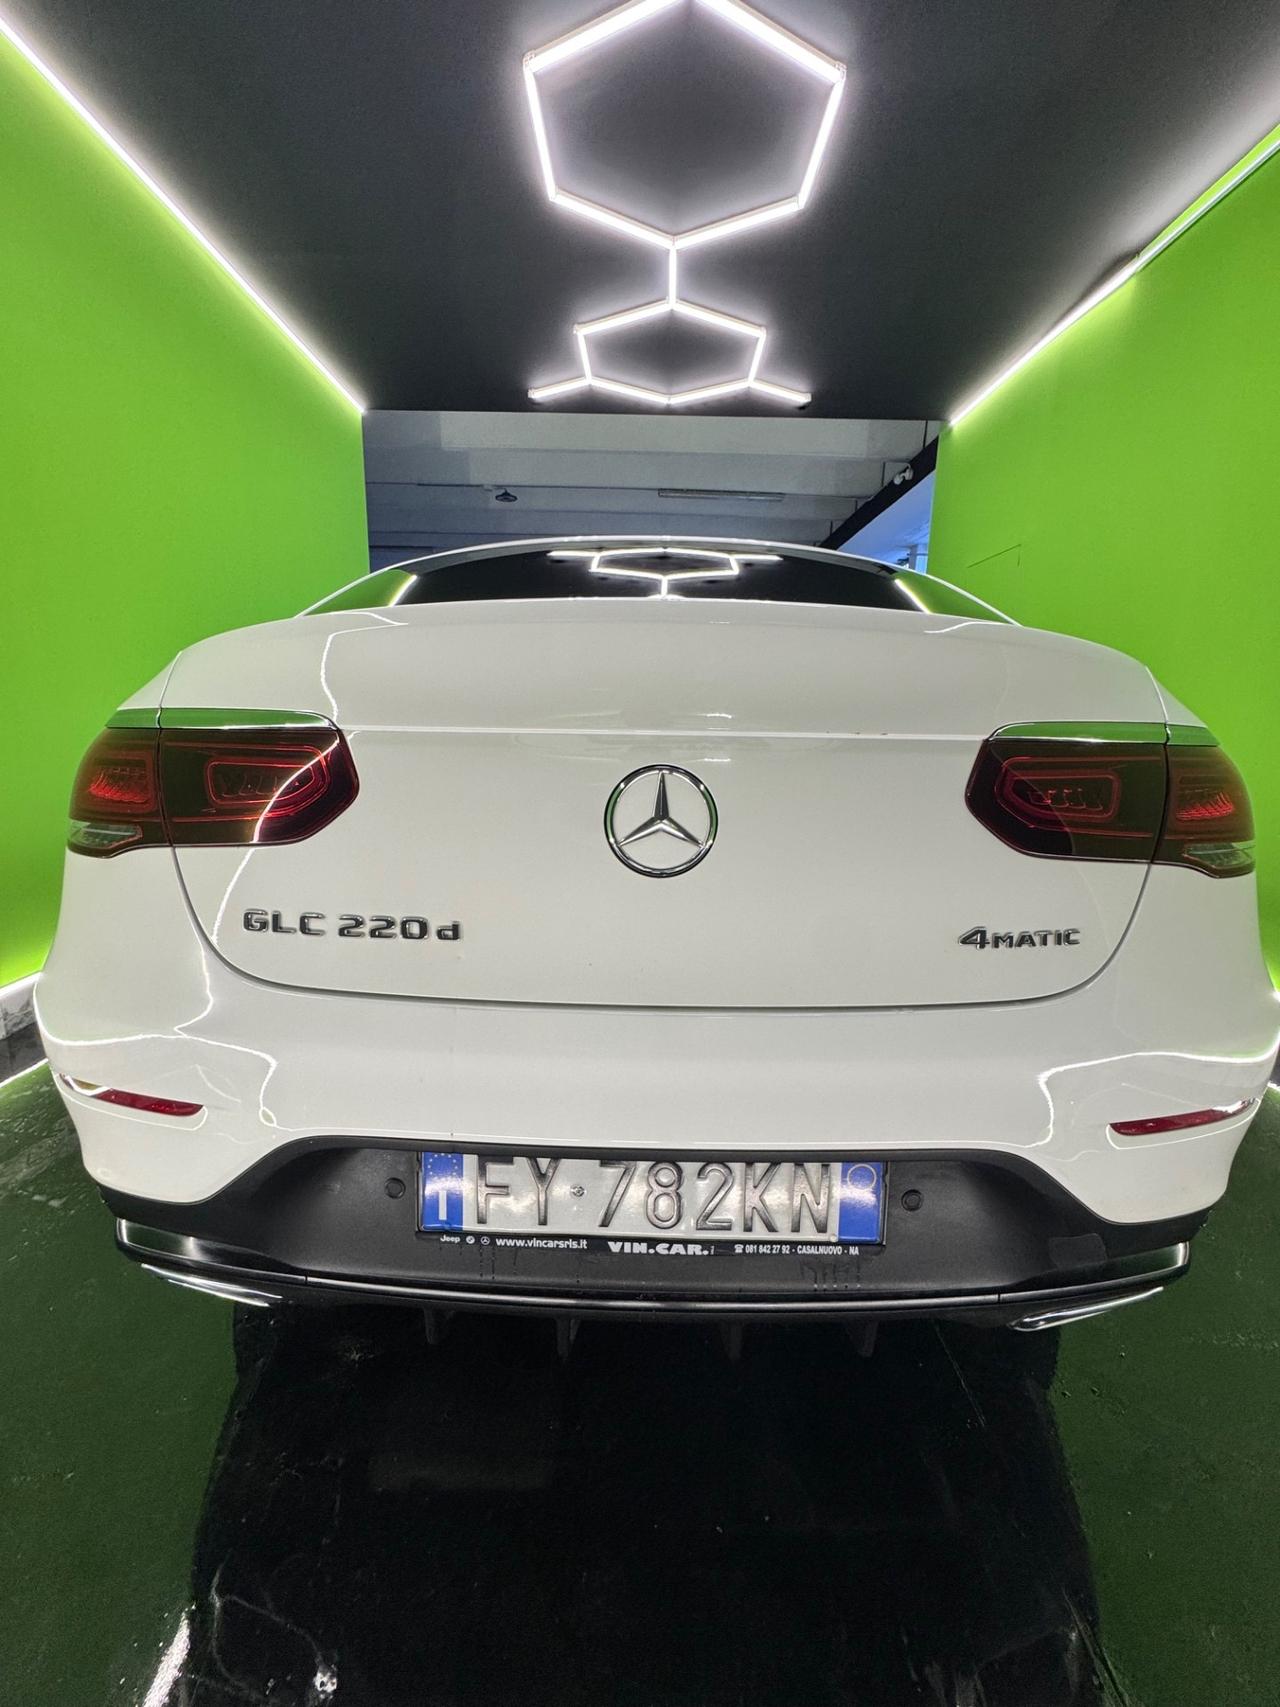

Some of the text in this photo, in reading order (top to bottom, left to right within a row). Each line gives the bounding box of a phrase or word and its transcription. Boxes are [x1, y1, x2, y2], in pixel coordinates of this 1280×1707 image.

[243, 908, 462, 940] GLC 220 d
[958, 926, 1081, 950] 4MATIC
[440, 1235, 461, 1244] Jeep
[772, 1244, 781, 1254] 27
[797, 1246, 842, 1255] CASALNUOVO
[849, 1246, 859, 1256] NA
